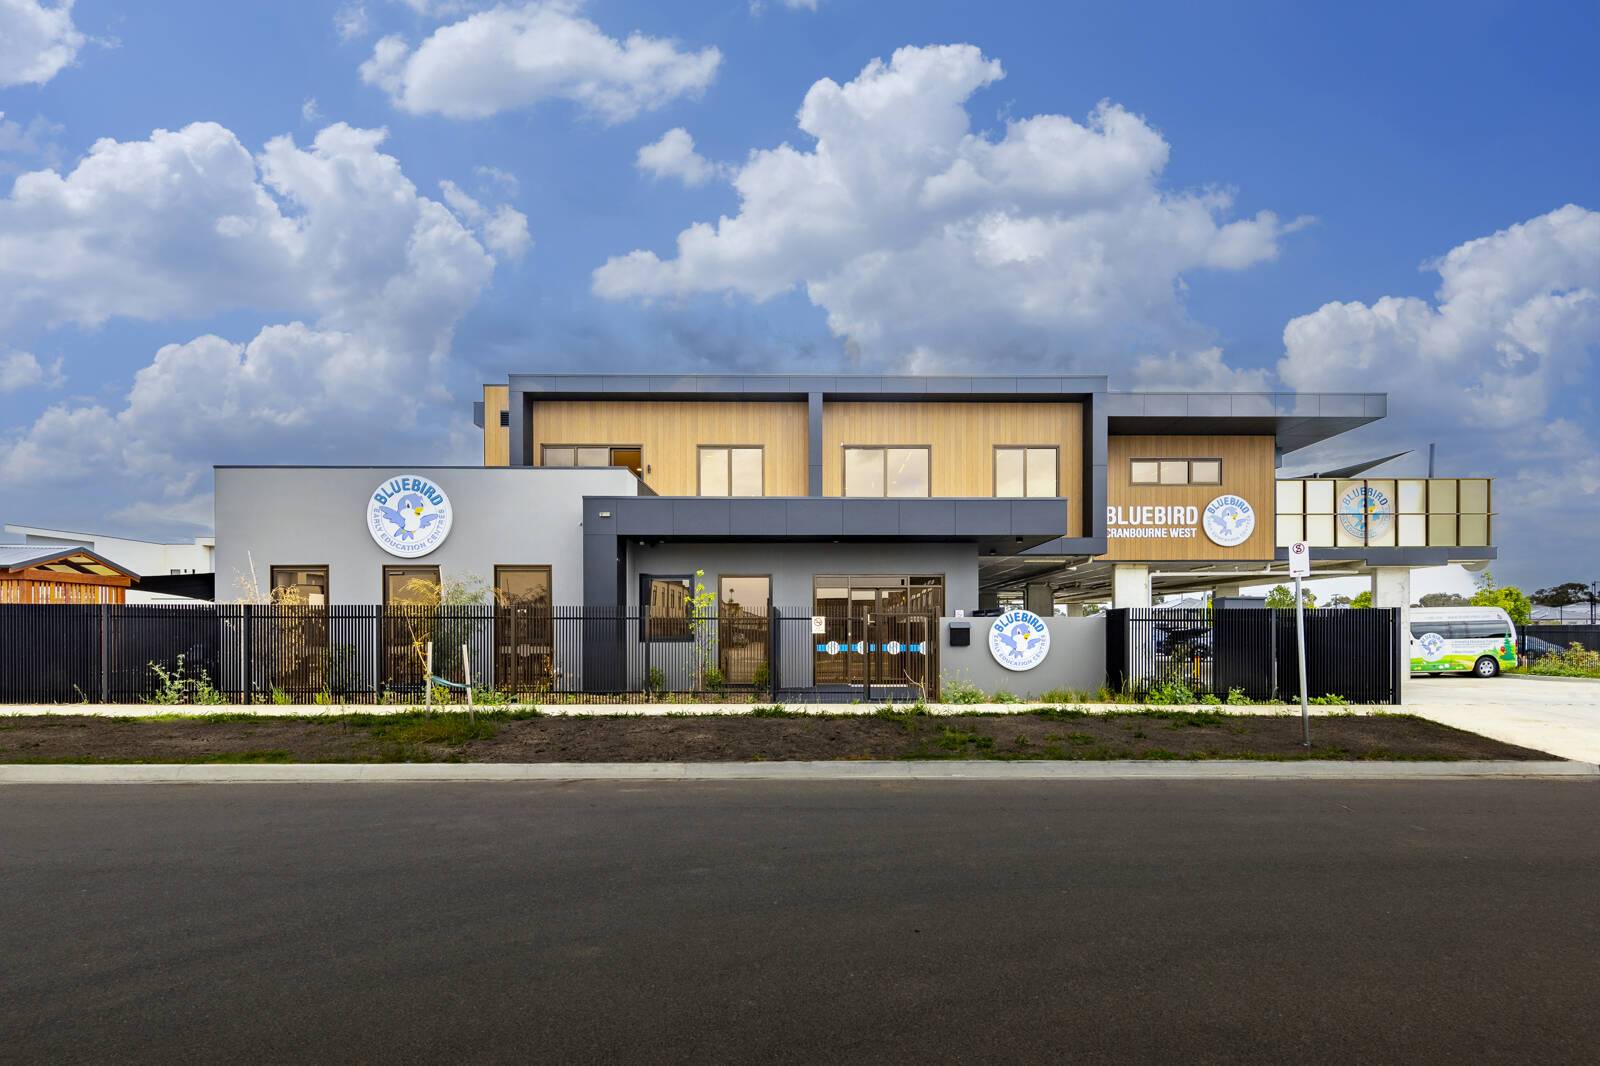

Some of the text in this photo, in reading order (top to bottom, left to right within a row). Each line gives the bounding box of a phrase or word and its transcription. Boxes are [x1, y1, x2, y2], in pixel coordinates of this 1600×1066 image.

[374, 478, 444, 506] BLUEBIRD
[1342, 487, 1388, 506] BLUEBIRD
[1207, 497, 1250, 514] BLUEBIRD
[1107, 506, 1198, 525] BLUEBIRD
[373, 508, 446, 551] EARLY EDUCATION CENTRES
[1170, 528, 1197, 538] WEST
[994, 612, 1045, 633] BLUEBIRD
